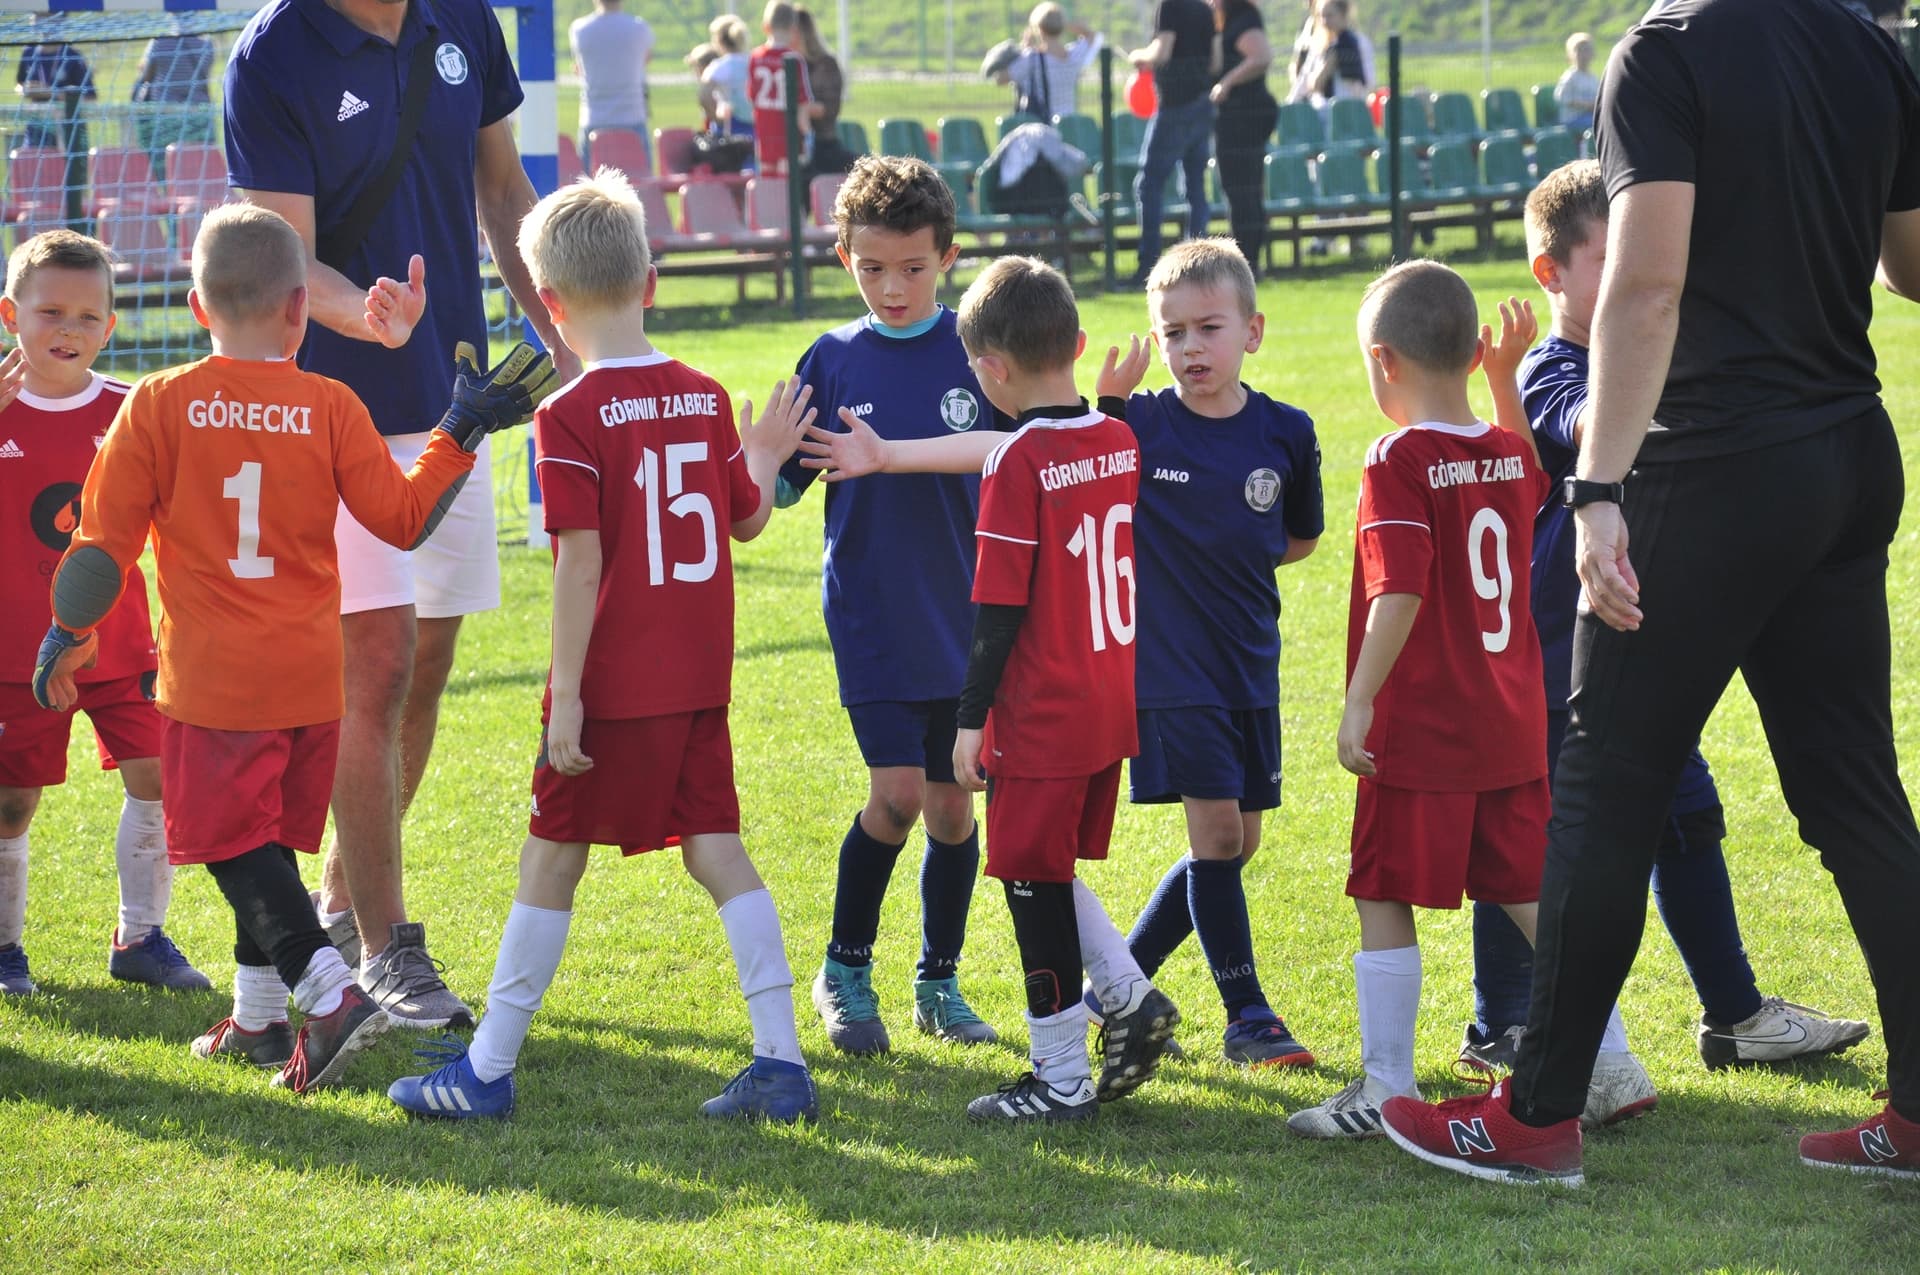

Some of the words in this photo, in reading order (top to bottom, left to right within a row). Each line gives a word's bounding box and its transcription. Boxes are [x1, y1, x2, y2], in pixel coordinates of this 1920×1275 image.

[337, 100, 369, 122] adidas
[187, 391, 311, 434] GÓRECKI
[599, 396, 659, 428] GÓRNIK
[662, 393, 718, 419] ZABRZE
[850, 402, 873, 417] AKO
[0, 450, 24, 458] didas
[1039, 457, 1097, 491] GÓRNIK
[1153, 467, 1190, 483] JAKO
[1427, 457, 1479, 489] GÓRNIK
[223, 461, 275, 579] 1
[633, 441, 718, 586] 15
[1066, 503, 1136, 652] 16
[1468, 507, 1512, 653] 9
[1214, 963, 1252, 982] JAKO
[1448, 1117, 1496, 1155] N
[1859, 1124, 1899, 1163] N
